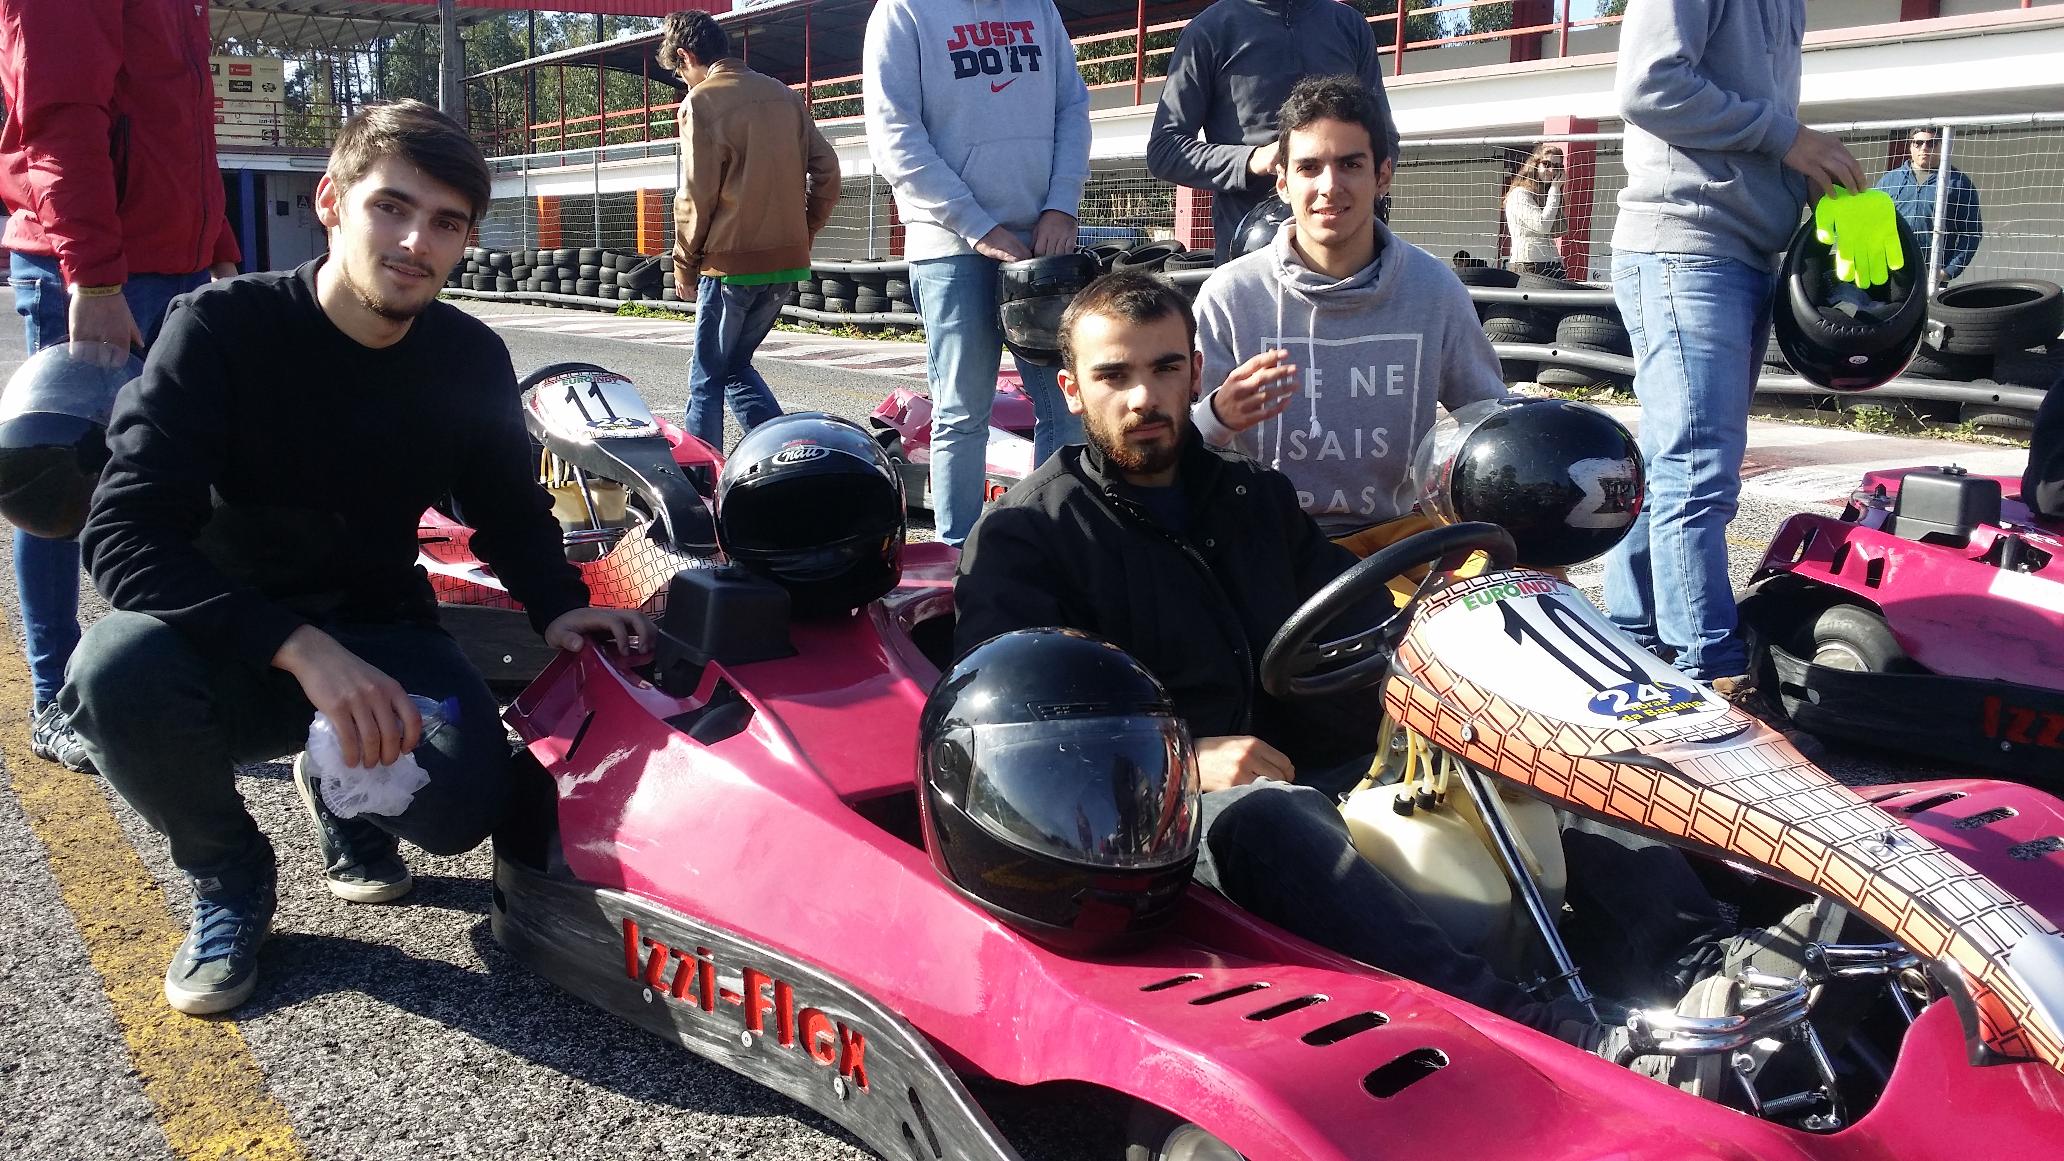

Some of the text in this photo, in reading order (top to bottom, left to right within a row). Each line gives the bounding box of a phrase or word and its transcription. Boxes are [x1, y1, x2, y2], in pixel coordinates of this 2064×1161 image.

[946, 20, 1035, 52] JUST
[949, 45, 1043, 80] DO IT
[561, 375, 620, 386] EUROINDY
[1350, 364, 1405, 398] NE
[564, 382, 618, 422] 11
[1287, 427, 1390, 461] SAIS
[1462, 579, 1561, 612] EUROINDY
[1496, 593, 1654, 692] 10
[1595, 684, 1673, 713] 24
[1621, 700, 1704, 722] da Batalha
